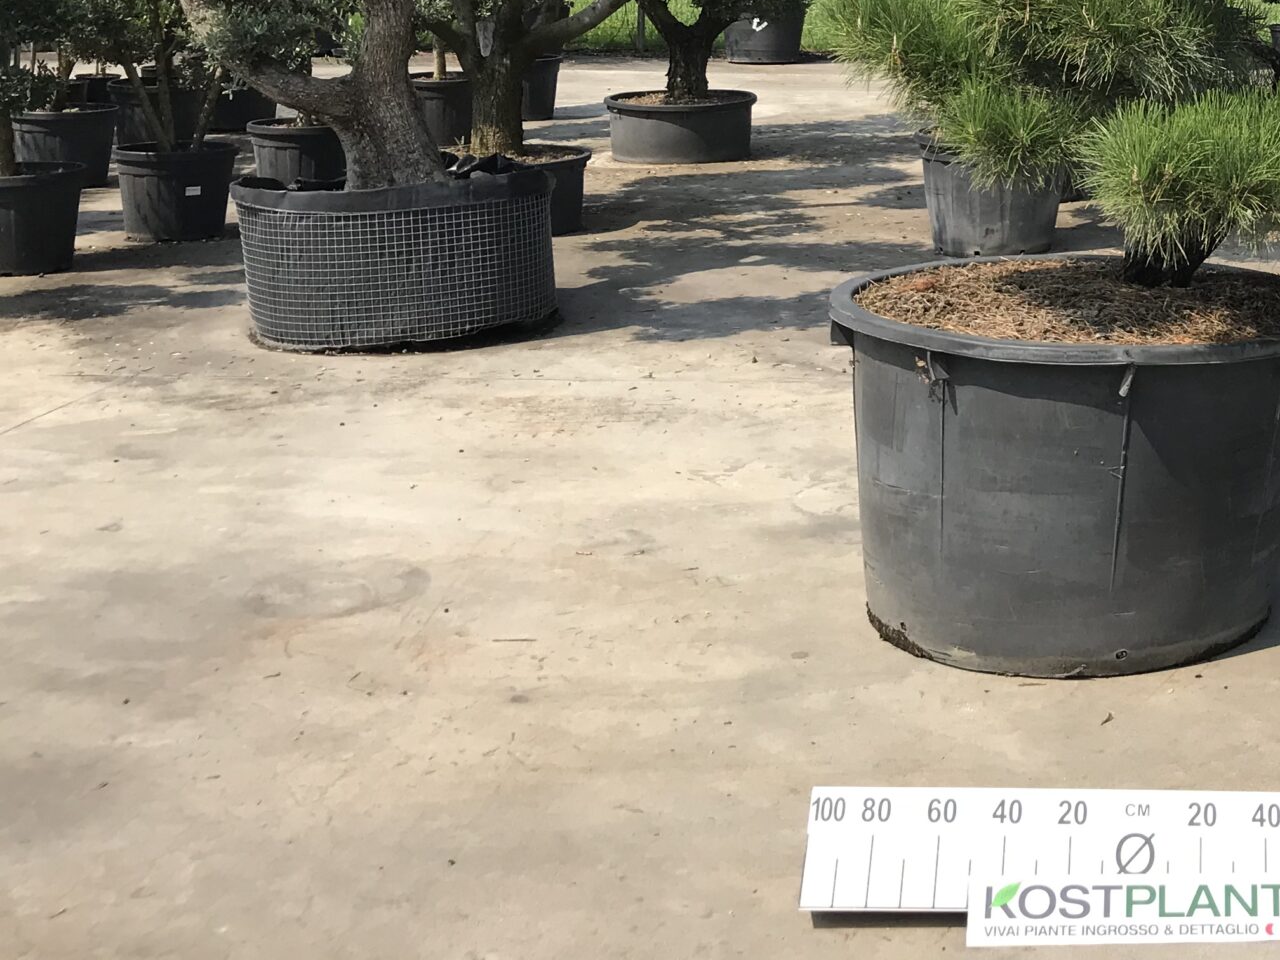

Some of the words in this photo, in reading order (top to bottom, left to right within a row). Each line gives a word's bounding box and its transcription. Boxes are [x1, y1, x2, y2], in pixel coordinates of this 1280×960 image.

[811, 796, 846, 822] 100
[861, 798, 892, 822] 80
[927, 798, 957, 823] 60
[992, 799, 1023, 824] 40
[1057, 800, 1088, 825] 20
[1125, 804, 1150, 817] CM
[1188, 802, 1217, 827] 20
[1251, 803, 1280, 828] 40
[984, 926, 1019, 937] VIVAI
[1024, 925, 1076, 937] PIANTE
[1081, 925, 1159, 936] INGROSSO
[1164, 925, 1173, 935] &
[1179, 924, 1259, 935] DETTAGLIO
